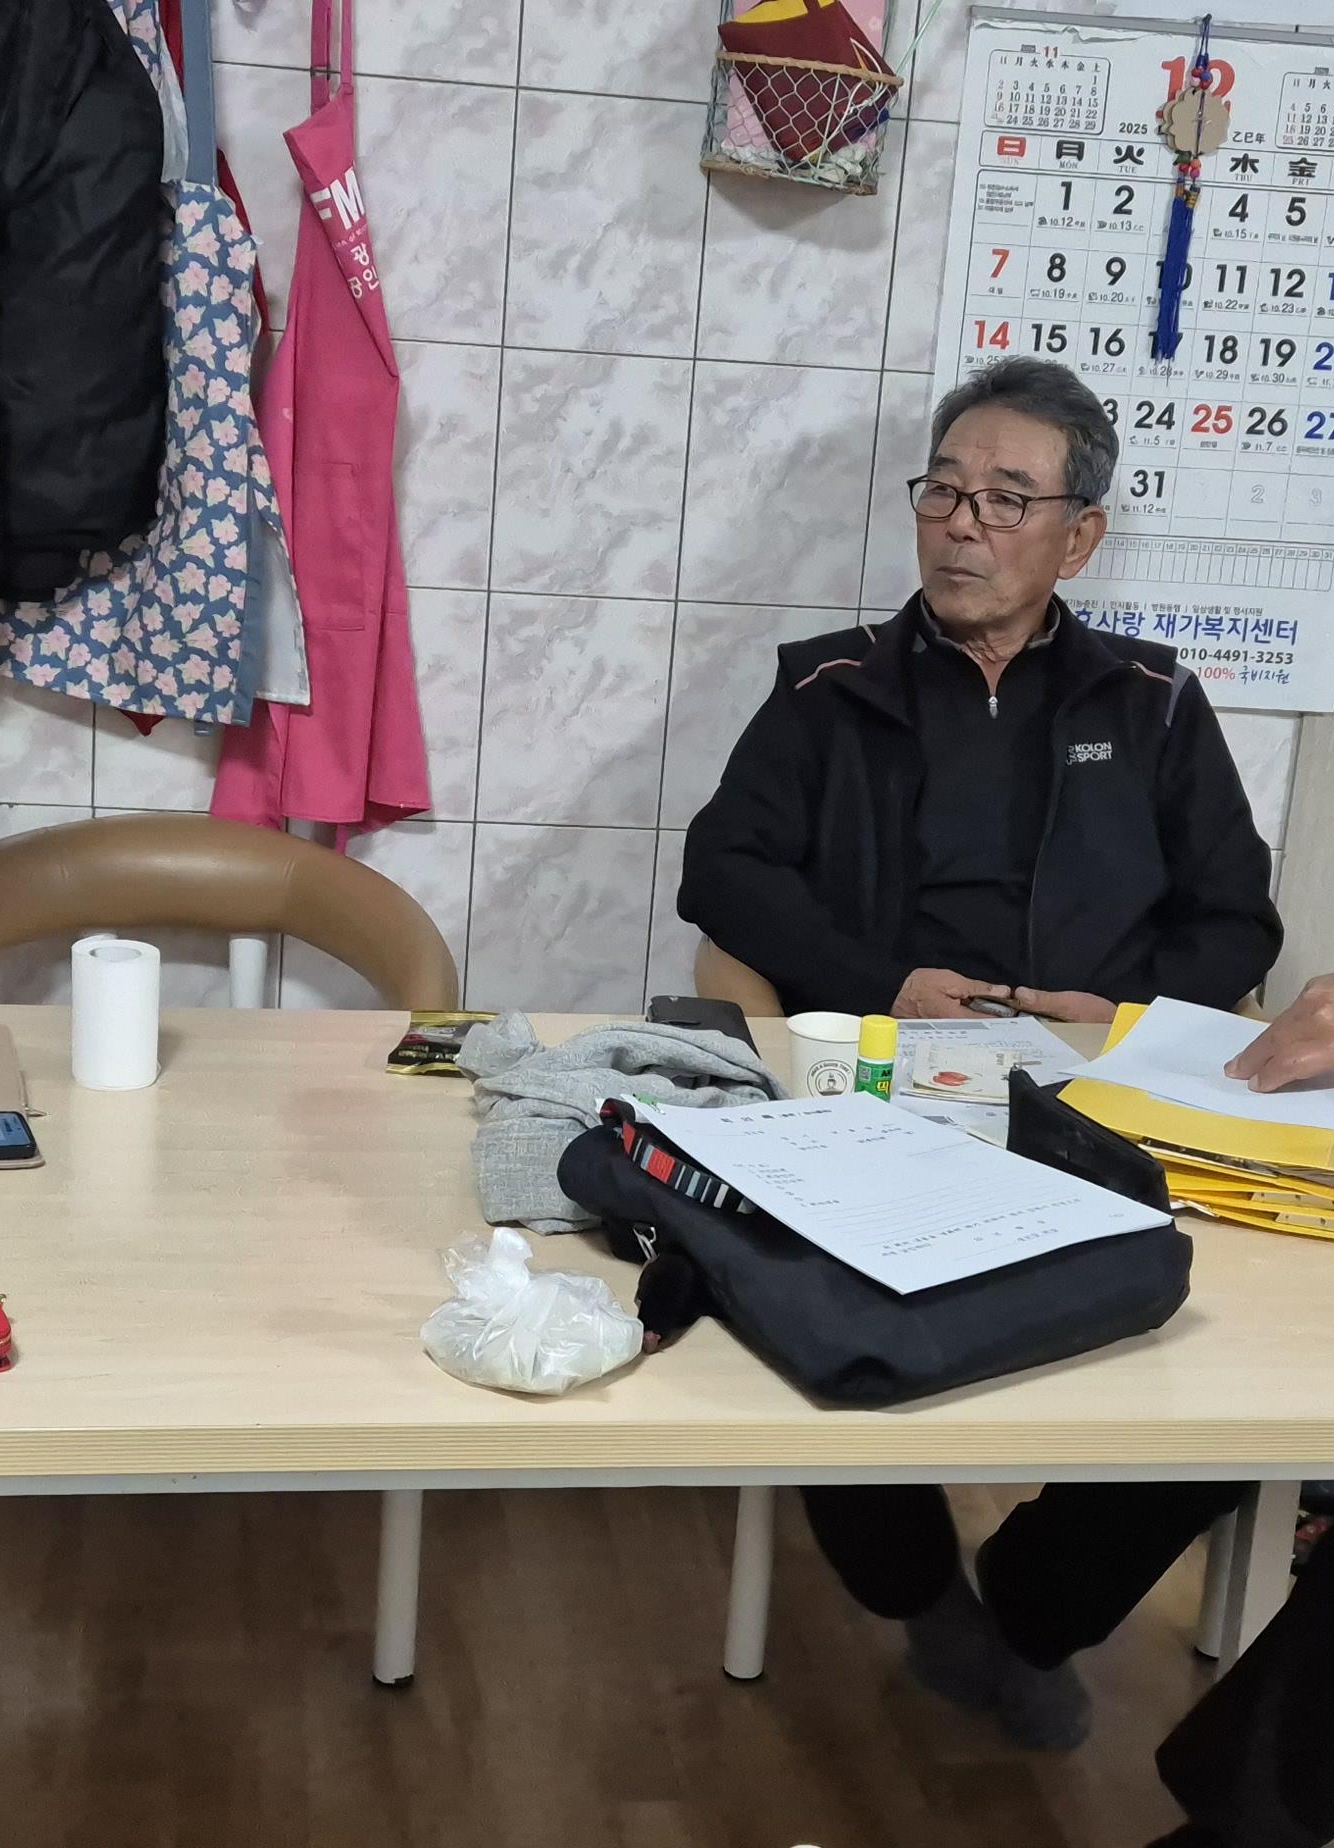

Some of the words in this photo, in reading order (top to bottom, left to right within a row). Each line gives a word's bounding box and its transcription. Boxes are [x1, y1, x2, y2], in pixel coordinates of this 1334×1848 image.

[1044, 46, 1058, 58] 11
[1013, 81, 1019, 90] 3
[1029, 83, 1034, 91] 4
[1044, 83, 1049, 92] 5
[1060, 84, 1065, 93] 6
[1076, 85, 1081, 94] 7
[1091, 87, 1096, 96] 8
[1010, 92, 1020, 101] 10
[1025, 94, 1034, 102] 11
[1041, 95, 1051, 104] 12
[1056, 96, 1067, 105] 13
[1072, 97, 1082, 106] 14
[1088, 98, 1098, 107] 15
[1009, 103, 1019, 112] 17
[1024, 105, 1034, 114] 18
[1040, 106, 1050, 116] 19
[1055, 107, 1066, 116] 20
[1071, 108, 1080, 118] 21
[1085, 110, 1097, 119] 22
[1305, 103, 1311, 112] 5
[1321, 104, 1326, 113] 6
[1007, 115, 1018, 124] 24
[1022, 117, 1033, 125] 25
[1038, 118, 1049, 127] 26
[1053, 119, 1064, 128] 27
[1069, 120, 1080, 129] 28
[1085, 121, 1096, 130] 29
[1288, 113, 1296, 123] 11
[1301, 114, 1312, 124] 12
[1317, 115, 1327, 125] 13
[1119, 122, 1148, 135] 2025
[1232, 131, 1266, 144] 乙巳年
[1300, 125, 1310, 135] 19
[1315, 126, 1326, 135] 20
[1297, 136, 1309, 146] 26
[1313, 138, 1324, 147] 27
[997, 136, 1026, 157] 日
[1056, 140, 1084, 161] 月
[1113, 145, 1144, 165] 火
[1288, 158, 1318, 178] 金
[1059, 161, 1078, 169] MON
[1235, 174, 1253, 182] THU
[1292, 178, 1309, 186] FRI
[1061, 181, 1072, 210] 1
[1113, 185, 1134, 215] 2
[1228, 194, 1249, 222] 4
[1285, 197, 1307, 226] 5
[991, 249, 1010, 278] 7
[1047, 253, 1066, 282] 8
[1105, 256, 1127, 286] 9
[1217, 264, 1247, 293] 11
[1270, 268, 1306, 298] 12
[974, 320, 1009, 349] 14
[1031, 323, 1067, 353] 15
[1089, 327, 1126, 357] 16
[1204, 335, 1238, 364] 18
[1260, 338, 1296, 367] 19
[1103, 399, 1118, 426] 3
[1134, 400, 1175, 430] 24
[1191, 404, 1233, 435] 25
[1246, 407, 1288, 436] 26
[1130, 469, 1165, 498] 31
[1251, 484, 1265, 503] 2
[1153, 613, 1298, 646] 재가복지센터
[1180, 648, 1293, 664] 010-4491-3253
[1198, 666, 1235, 680] 100%
[1239, 665, 1289, 685] 국비지원
[1075, 742, 1112, 752] KOLON
[1077, 751, 1112, 762] SPORT
